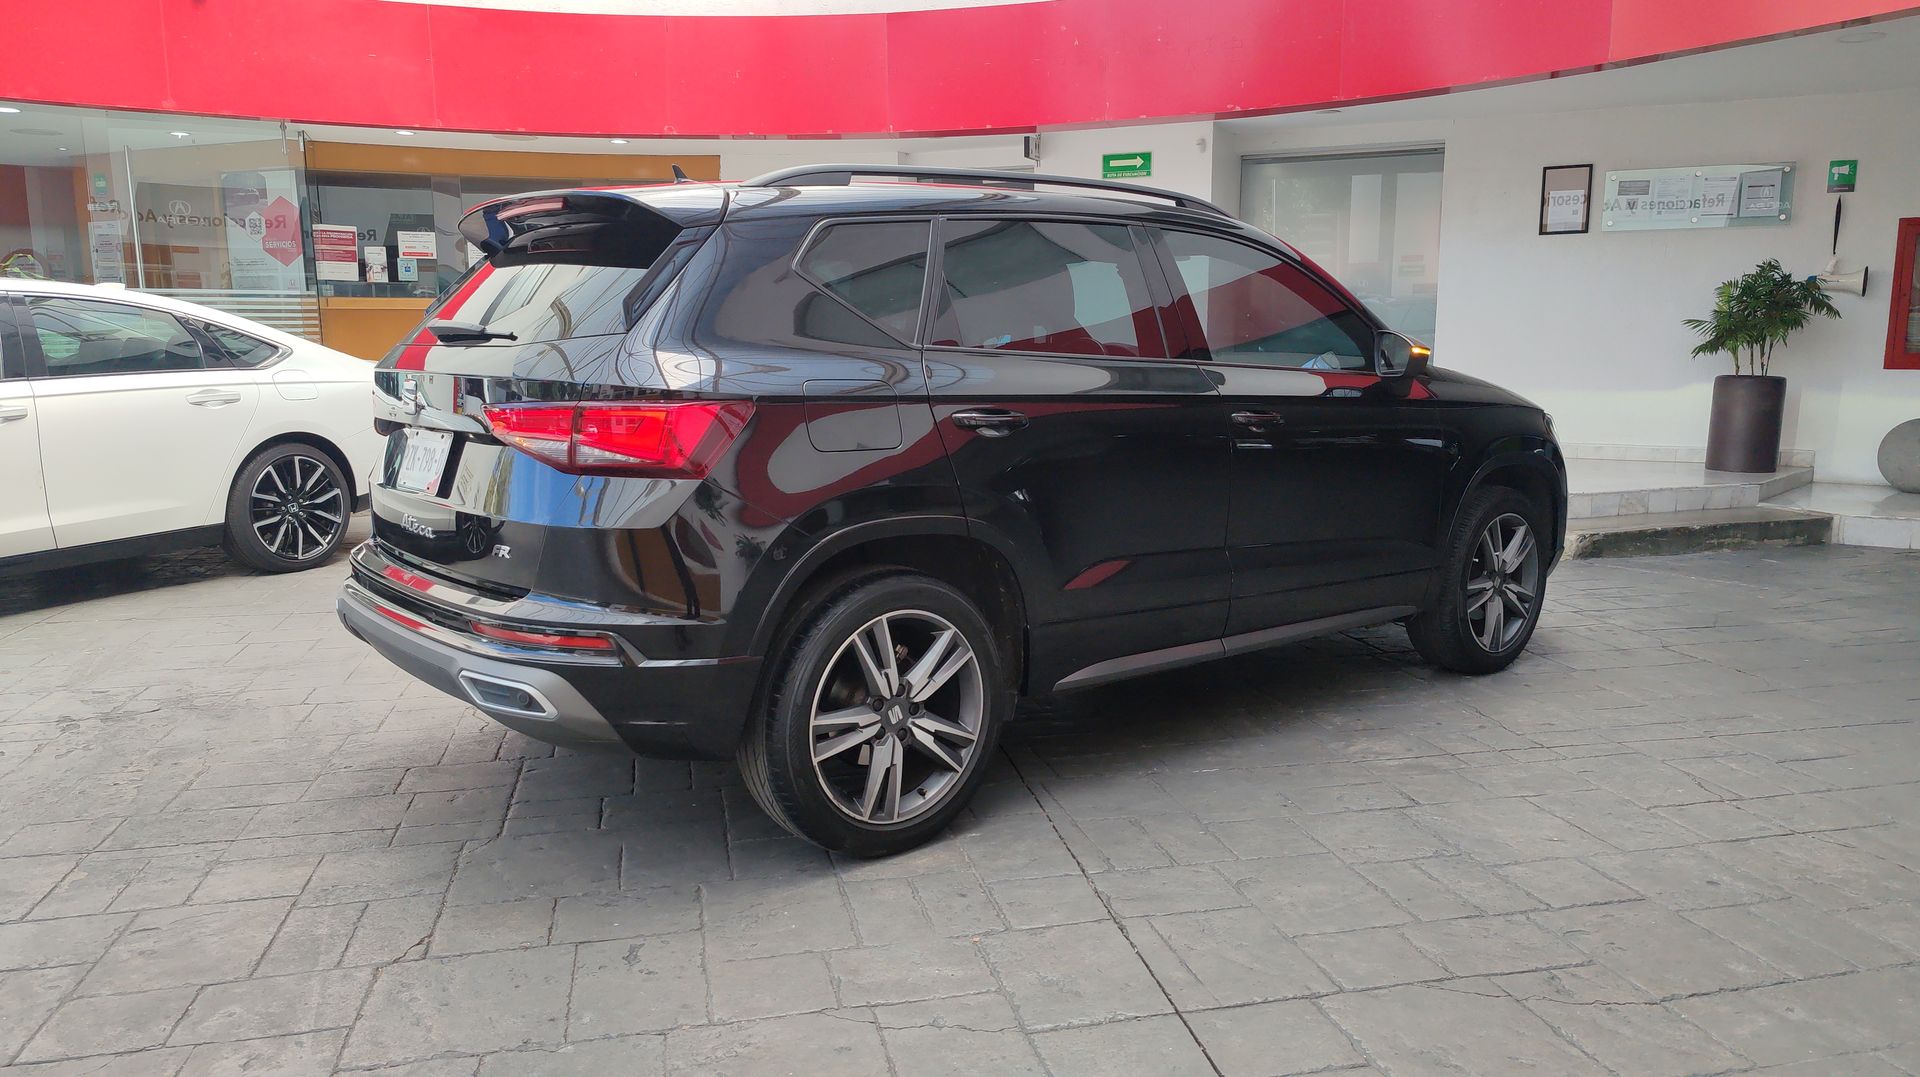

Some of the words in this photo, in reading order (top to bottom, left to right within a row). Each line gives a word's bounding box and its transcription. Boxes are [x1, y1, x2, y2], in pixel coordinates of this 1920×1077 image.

[265, 240, 297, 249] SERVICIOS
[401, 513, 437, 539] Ateca
[492, 544, 511, 559] FR
